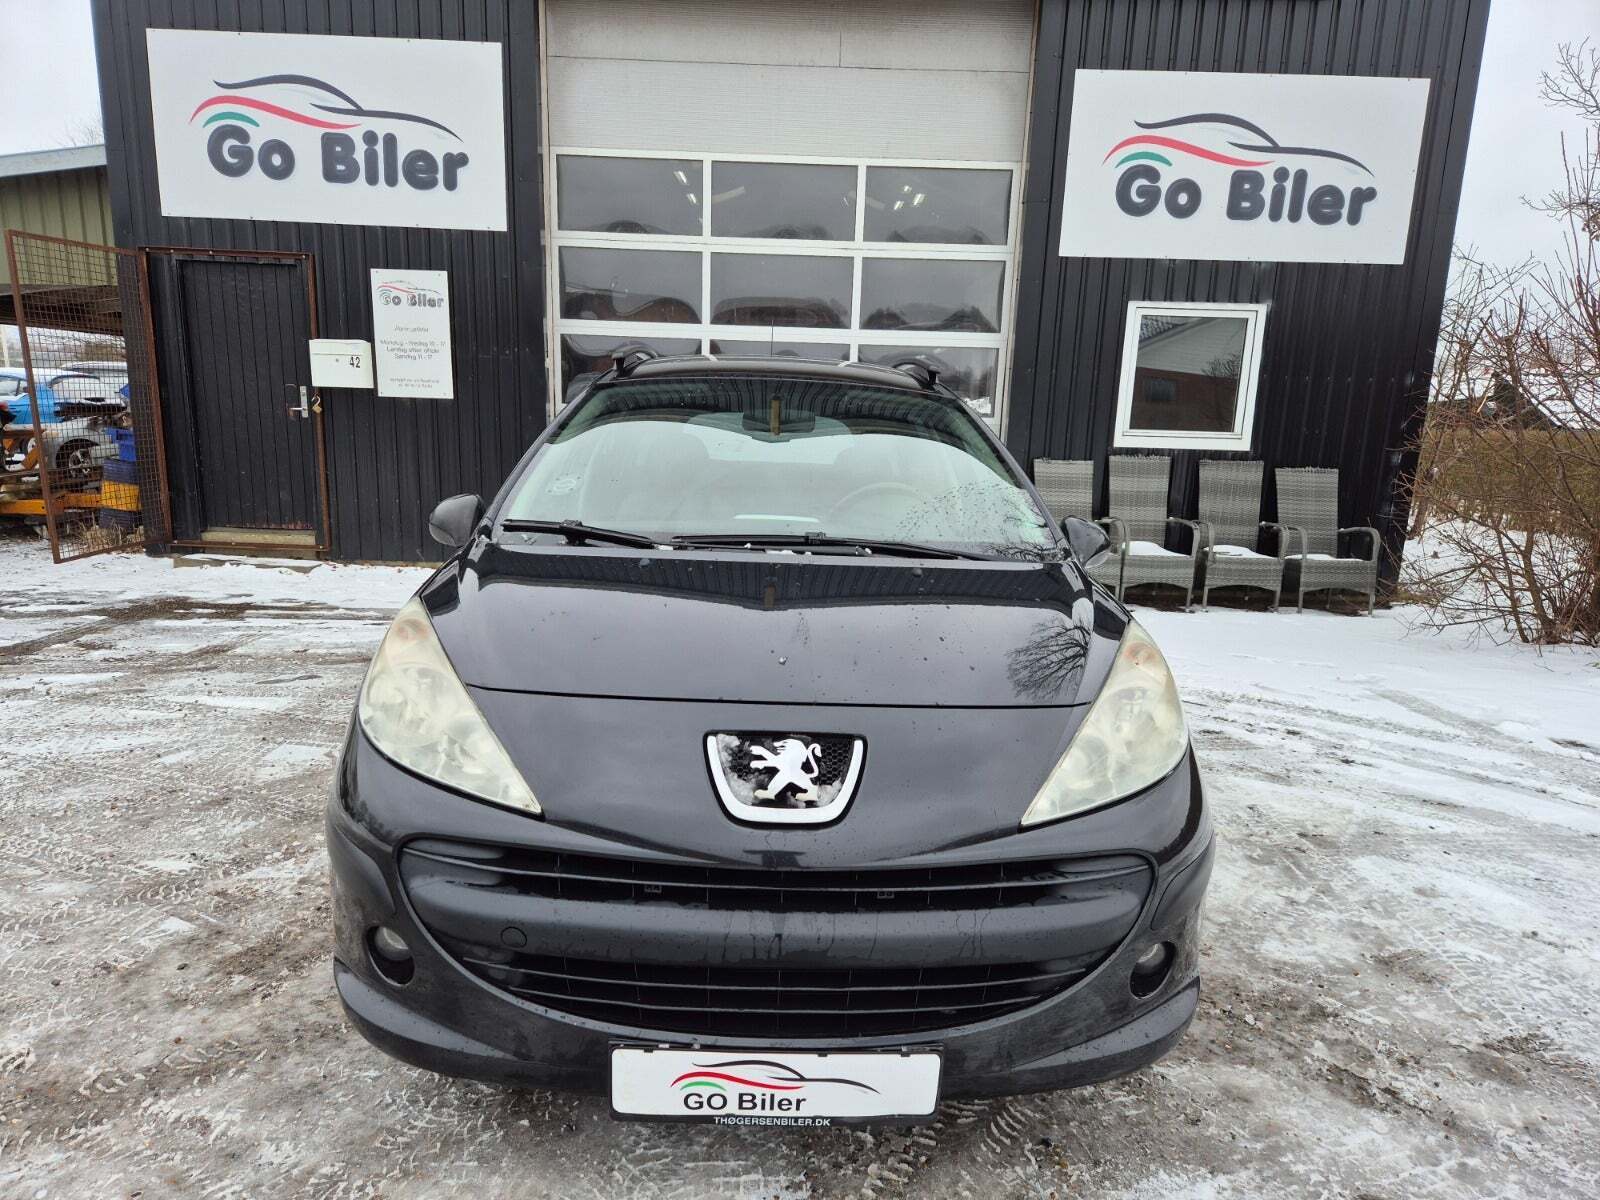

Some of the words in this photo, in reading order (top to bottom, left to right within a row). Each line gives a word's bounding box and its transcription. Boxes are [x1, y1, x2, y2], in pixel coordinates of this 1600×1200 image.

[207, 124, 295, 180] Go
[321, 130, 469, 191] Biler
[1115, 164, 1202, 219] Go
[1226, 166, 1378, 226] Biler
[380, 292, 402, 306] Go
[407, 293, 444, 308] Biler
[350, 356, 360, 368] 42
[683, 1092, 728, 1111] GO
[738, 1092, 807, 1112] Biler
[713, 1116, 831, 1127] THØGERSENBILER.DK
